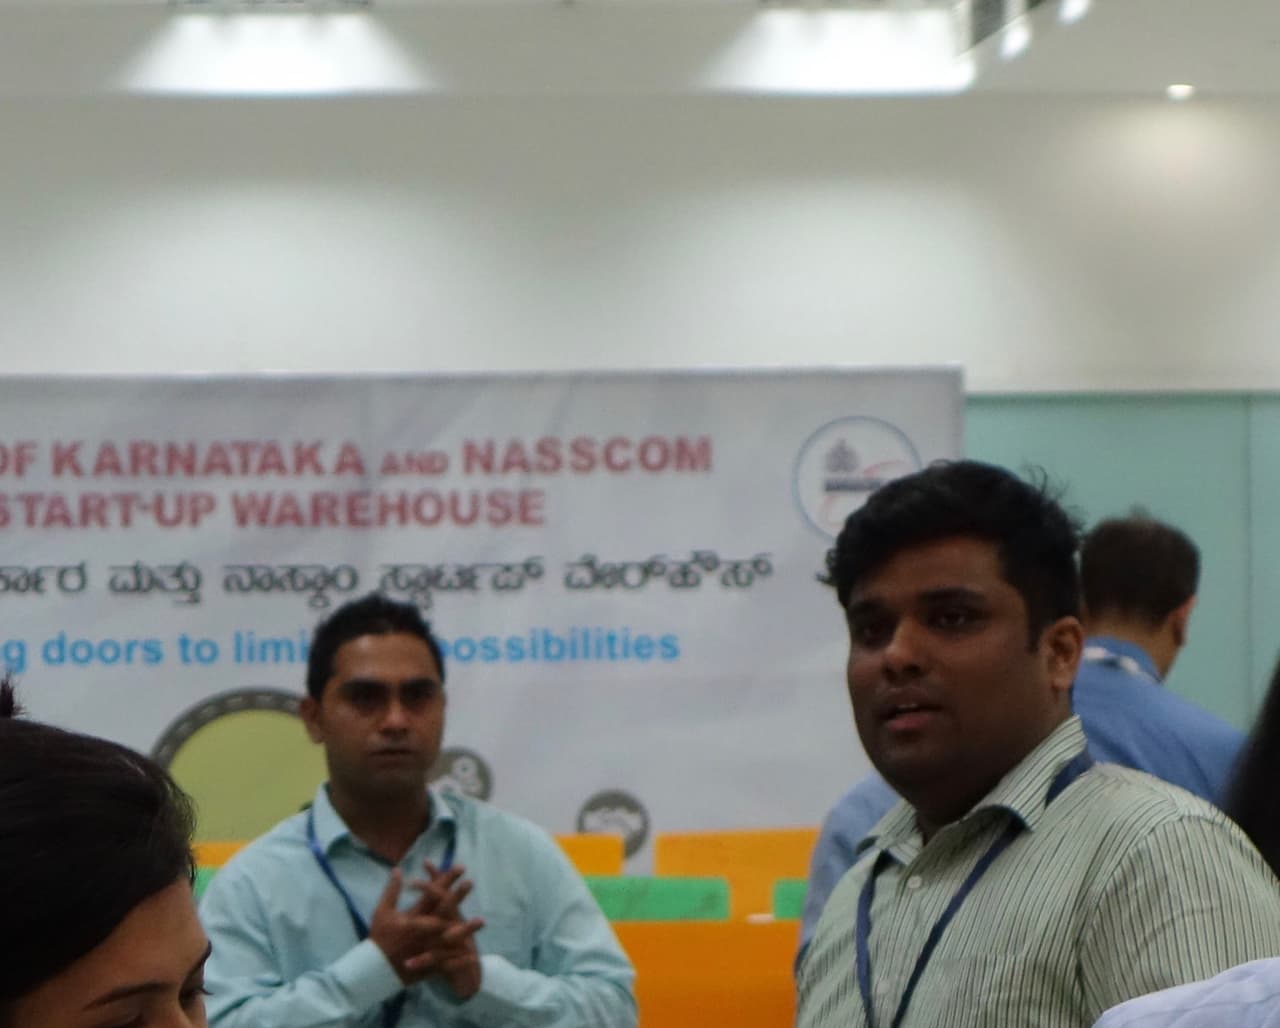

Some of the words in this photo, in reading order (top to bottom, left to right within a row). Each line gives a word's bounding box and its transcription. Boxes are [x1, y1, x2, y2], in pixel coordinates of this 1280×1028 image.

[51, 438, 365, 478] KARNATAKA
[381, 450, 449, 476] AND
[462, 435, 713, 475] NASSCOM
[231, 489, 546, 528] WAREHOUSE
[42, 630, 164, 665] doors
[179, 633, 219, 665] to
[233, 630, 307, 665] limi
[440, 628, 681, 664] ossibilities
